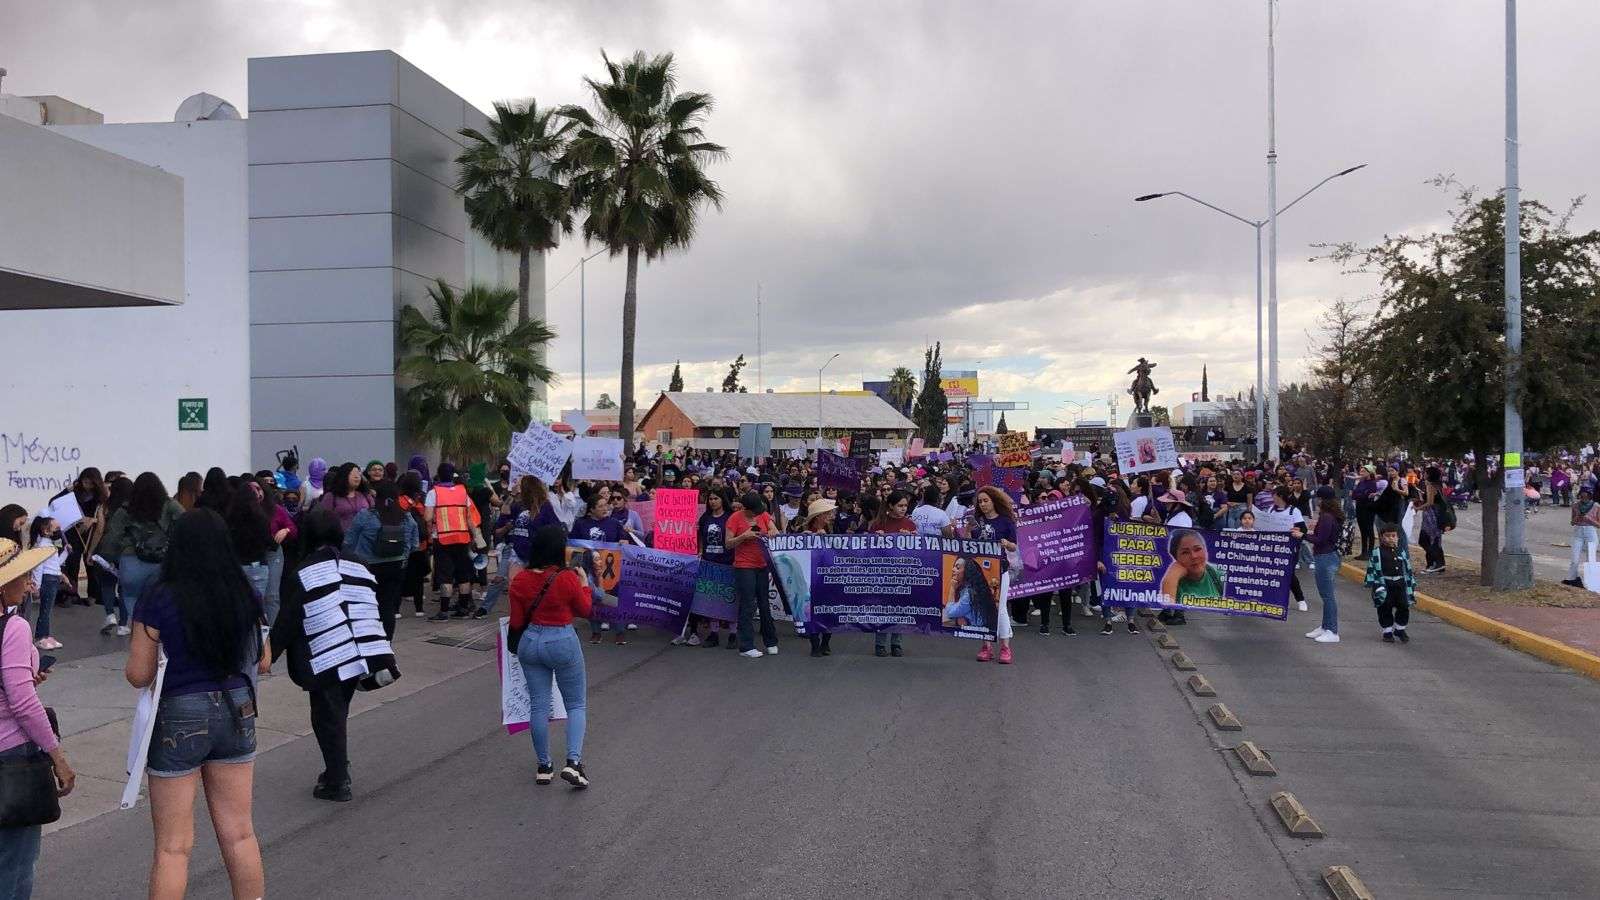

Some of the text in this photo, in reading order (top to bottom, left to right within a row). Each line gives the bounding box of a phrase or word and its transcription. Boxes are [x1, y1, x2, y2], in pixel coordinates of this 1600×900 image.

[2, 432, 81, 464] México
[1073, 524, 1089, 532] vida
[1110, 524, 1168, 537] JUSTICIA
[766, 536, 804, 550] OMOS
[807, 536, 823, 549] LA
[825, 536, 849, 550] VOZ
[852, 536, 868, 550] DE
[870, 536, 894, 549] LAS
[897, 536, 922, 551] QUE
[925, 536, 940, 551] YA
[942, 538, 960, 552] NO
[1258, 533, 1290, 542] justicia
[1119, 538, 1155, 551] PARA
[1261, 543, 1273, 552] del
[1050, 550, 1084, 562] hermana
[1112, 554, 1161, 567] TERESA
[1216, 551, 1290, 566] de Chihuahua, que
[1118, 569, 1153, 582] BACA
[1229, 564, 1254, 573] queda
[1255, 565, 1285, 576] impune
[1229, 576, 1269, 586] asesinato
[1270, 578, 1281, 587] de
[1235, 586, 1263, 597] Teresa
[1182, 595, 1284, 614] #JusticiaParaTeresa
